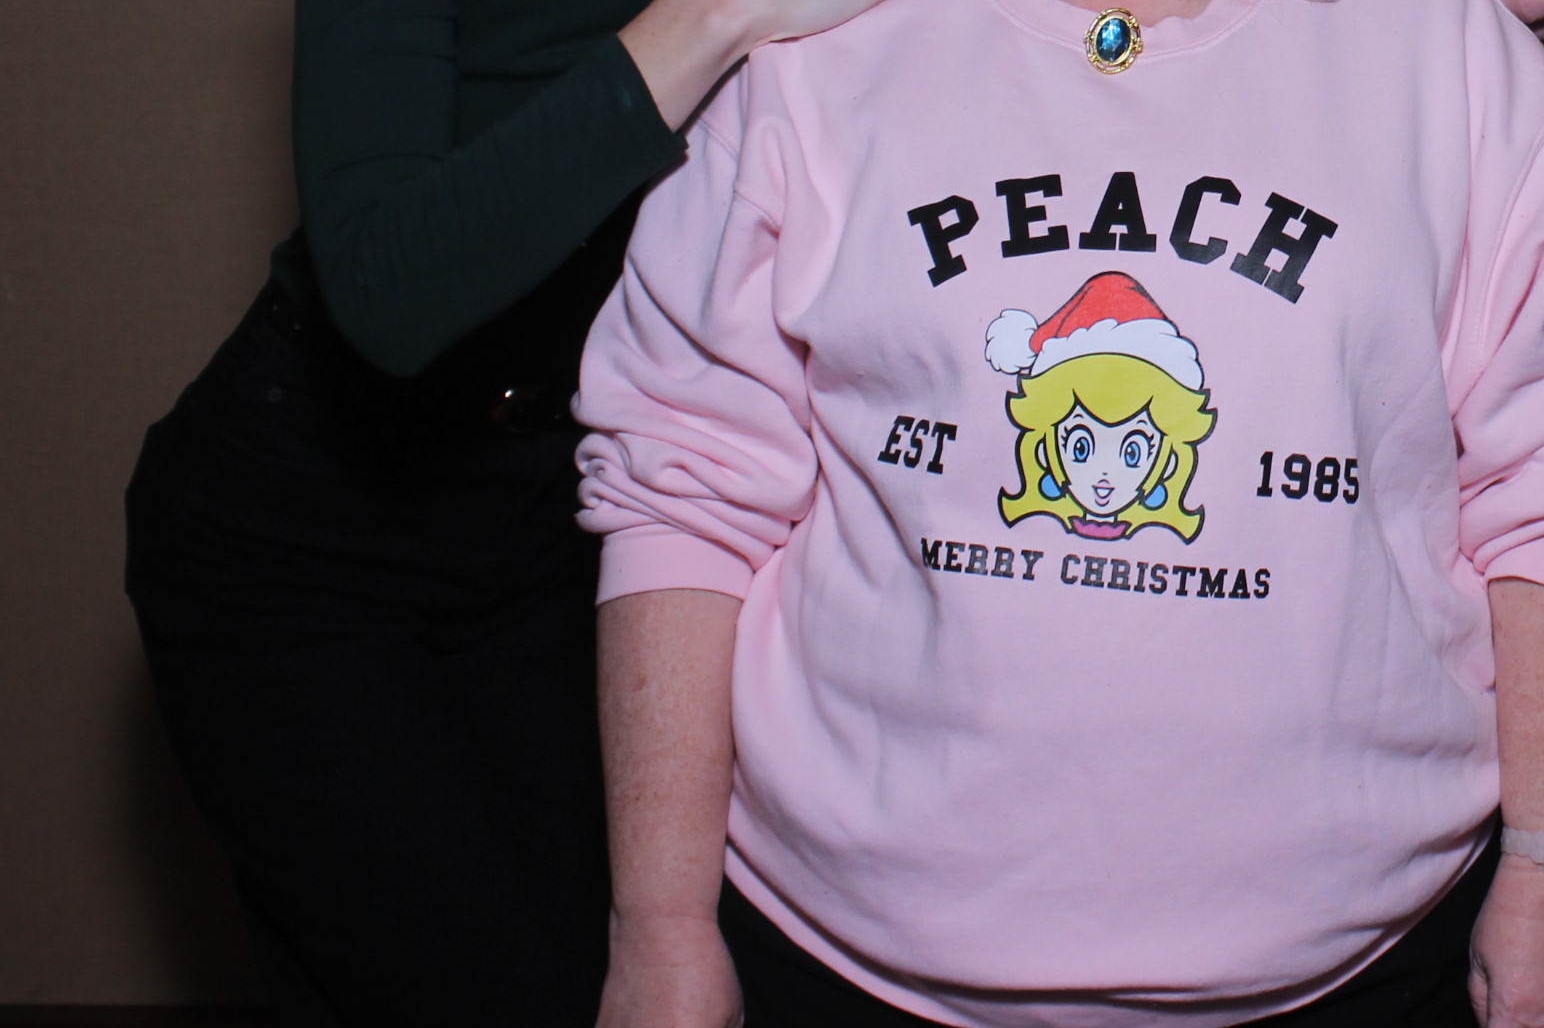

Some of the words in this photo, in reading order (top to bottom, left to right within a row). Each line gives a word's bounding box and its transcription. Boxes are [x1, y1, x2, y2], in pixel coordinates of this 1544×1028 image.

[907, 171, 1339, 304] PEACH
[877, 415, 958, 474] EST
[1256, 451, 1360, 504] 1985
[920, 537, 1044, 581] MERRY
[1060, 553, 1272, 600] CHRISTMAS
